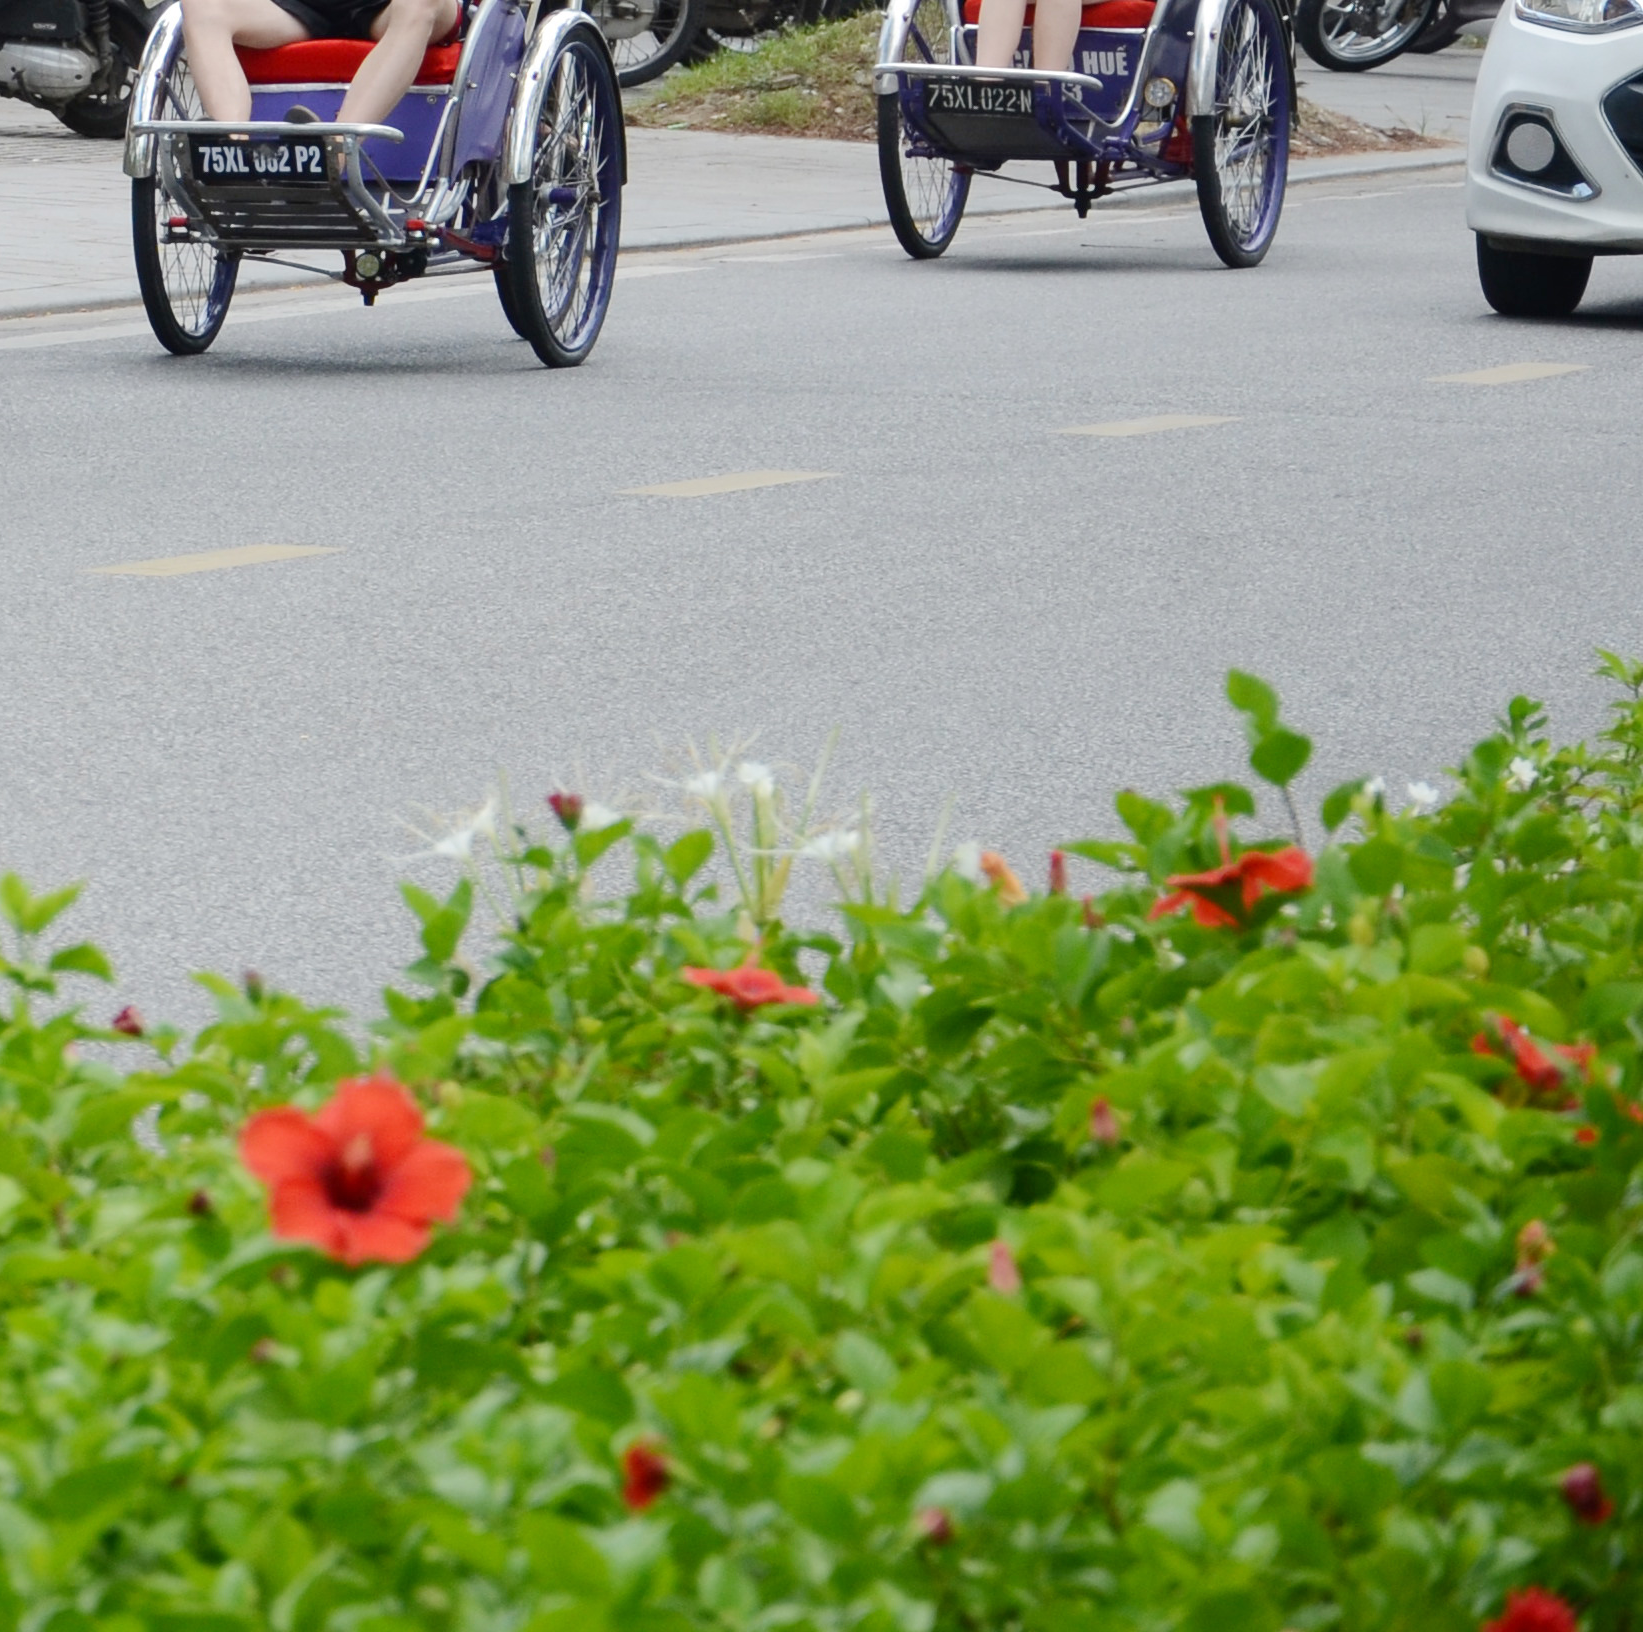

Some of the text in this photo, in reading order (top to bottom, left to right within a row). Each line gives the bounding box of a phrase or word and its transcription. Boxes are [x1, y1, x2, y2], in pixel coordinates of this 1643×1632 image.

[1081, 44, 1129, 77] HUẾ
[199, 146, 249, 172] 75XL
[295, 146, 322, 172] P2
